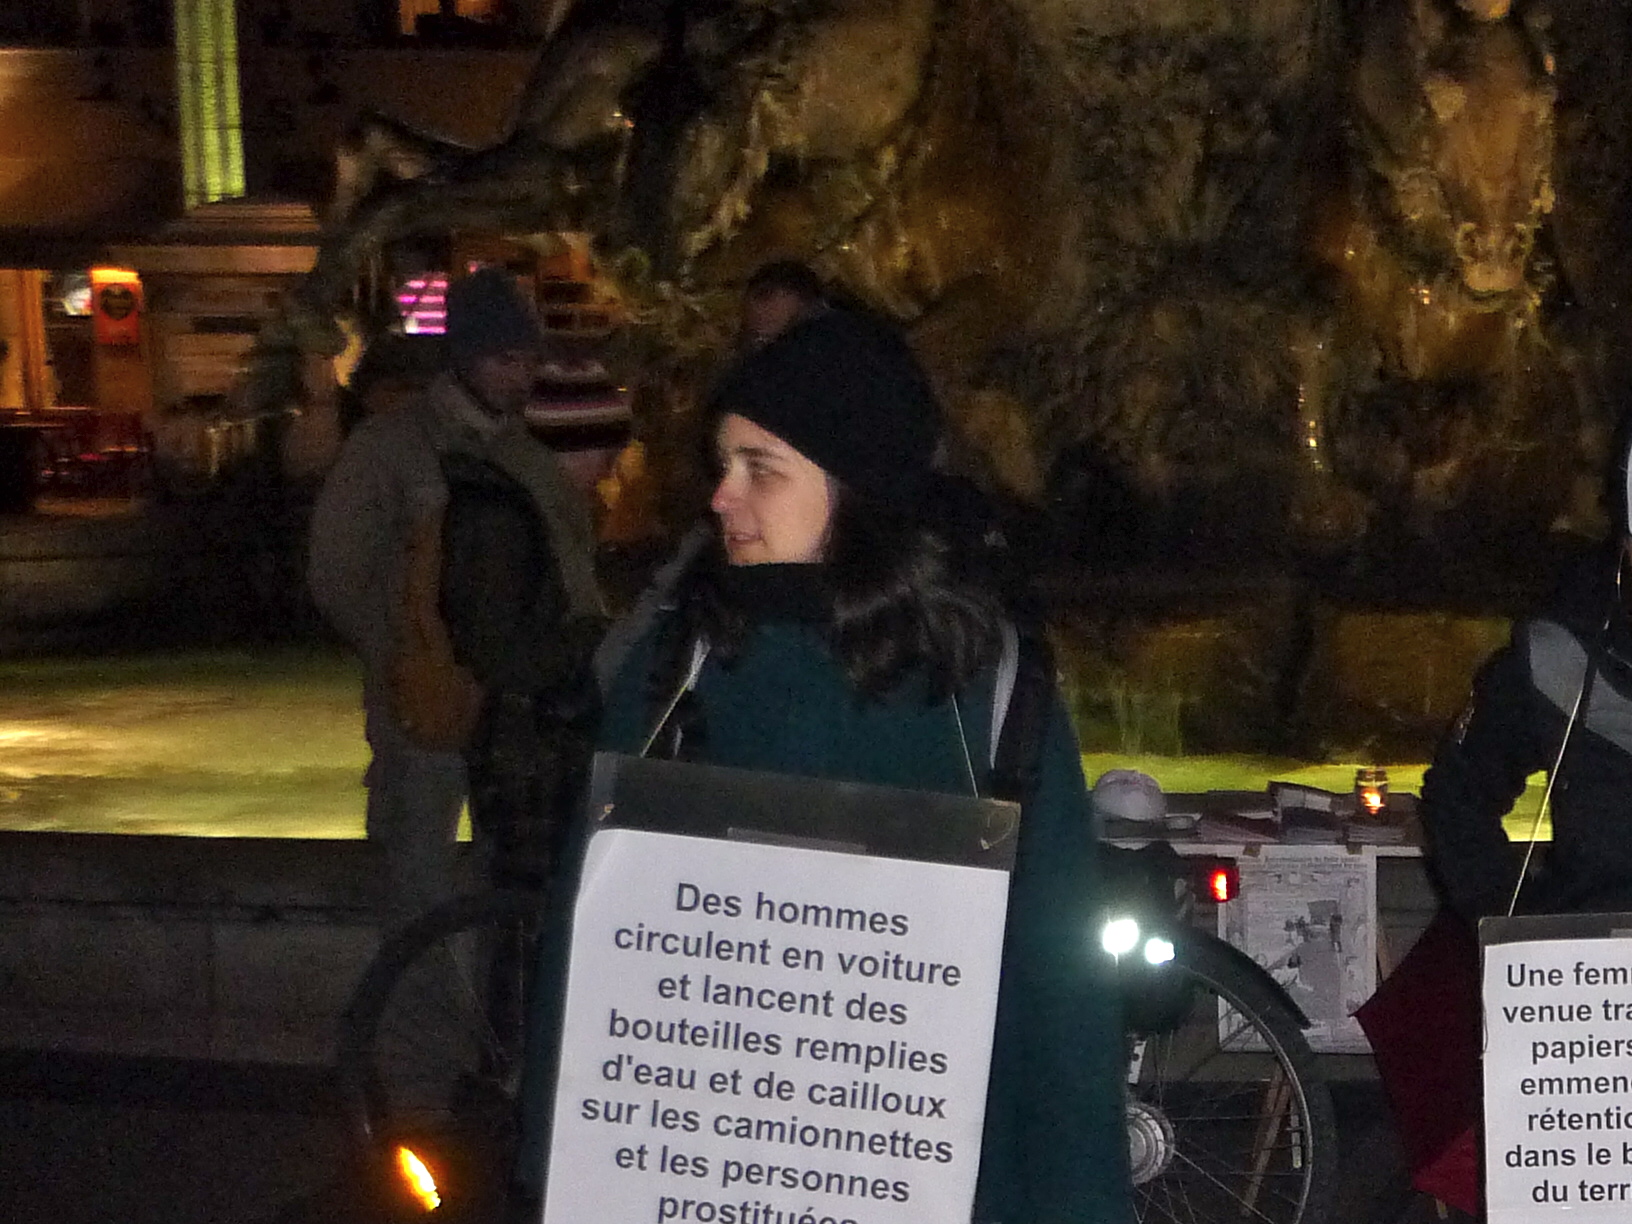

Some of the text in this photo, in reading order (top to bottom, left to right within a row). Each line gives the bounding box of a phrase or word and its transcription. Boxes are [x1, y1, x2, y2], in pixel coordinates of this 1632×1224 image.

[675, 882, 909, 937] Des hommes
[614, 922, 962, 987] circulent en voiture
[1507, 963, 1564, 988] Une
[657, 973, 908, 1026] et lancent des
[1502, 1003, 1593, 1024] venue
[608, 1007, 948, 1075] bouteilles remplies
[601, 1053, 947, 1119] d'eau et de cailloux
[580, 1098, 954, 1164] sur les camionnettes
[1505, 1144, 1577, 1168] dans
[1587, 1141, 1612, 1166] le
[615, 1143, 910, 1203] et les personnes
[1531, 1178, 1569, 1203] du
